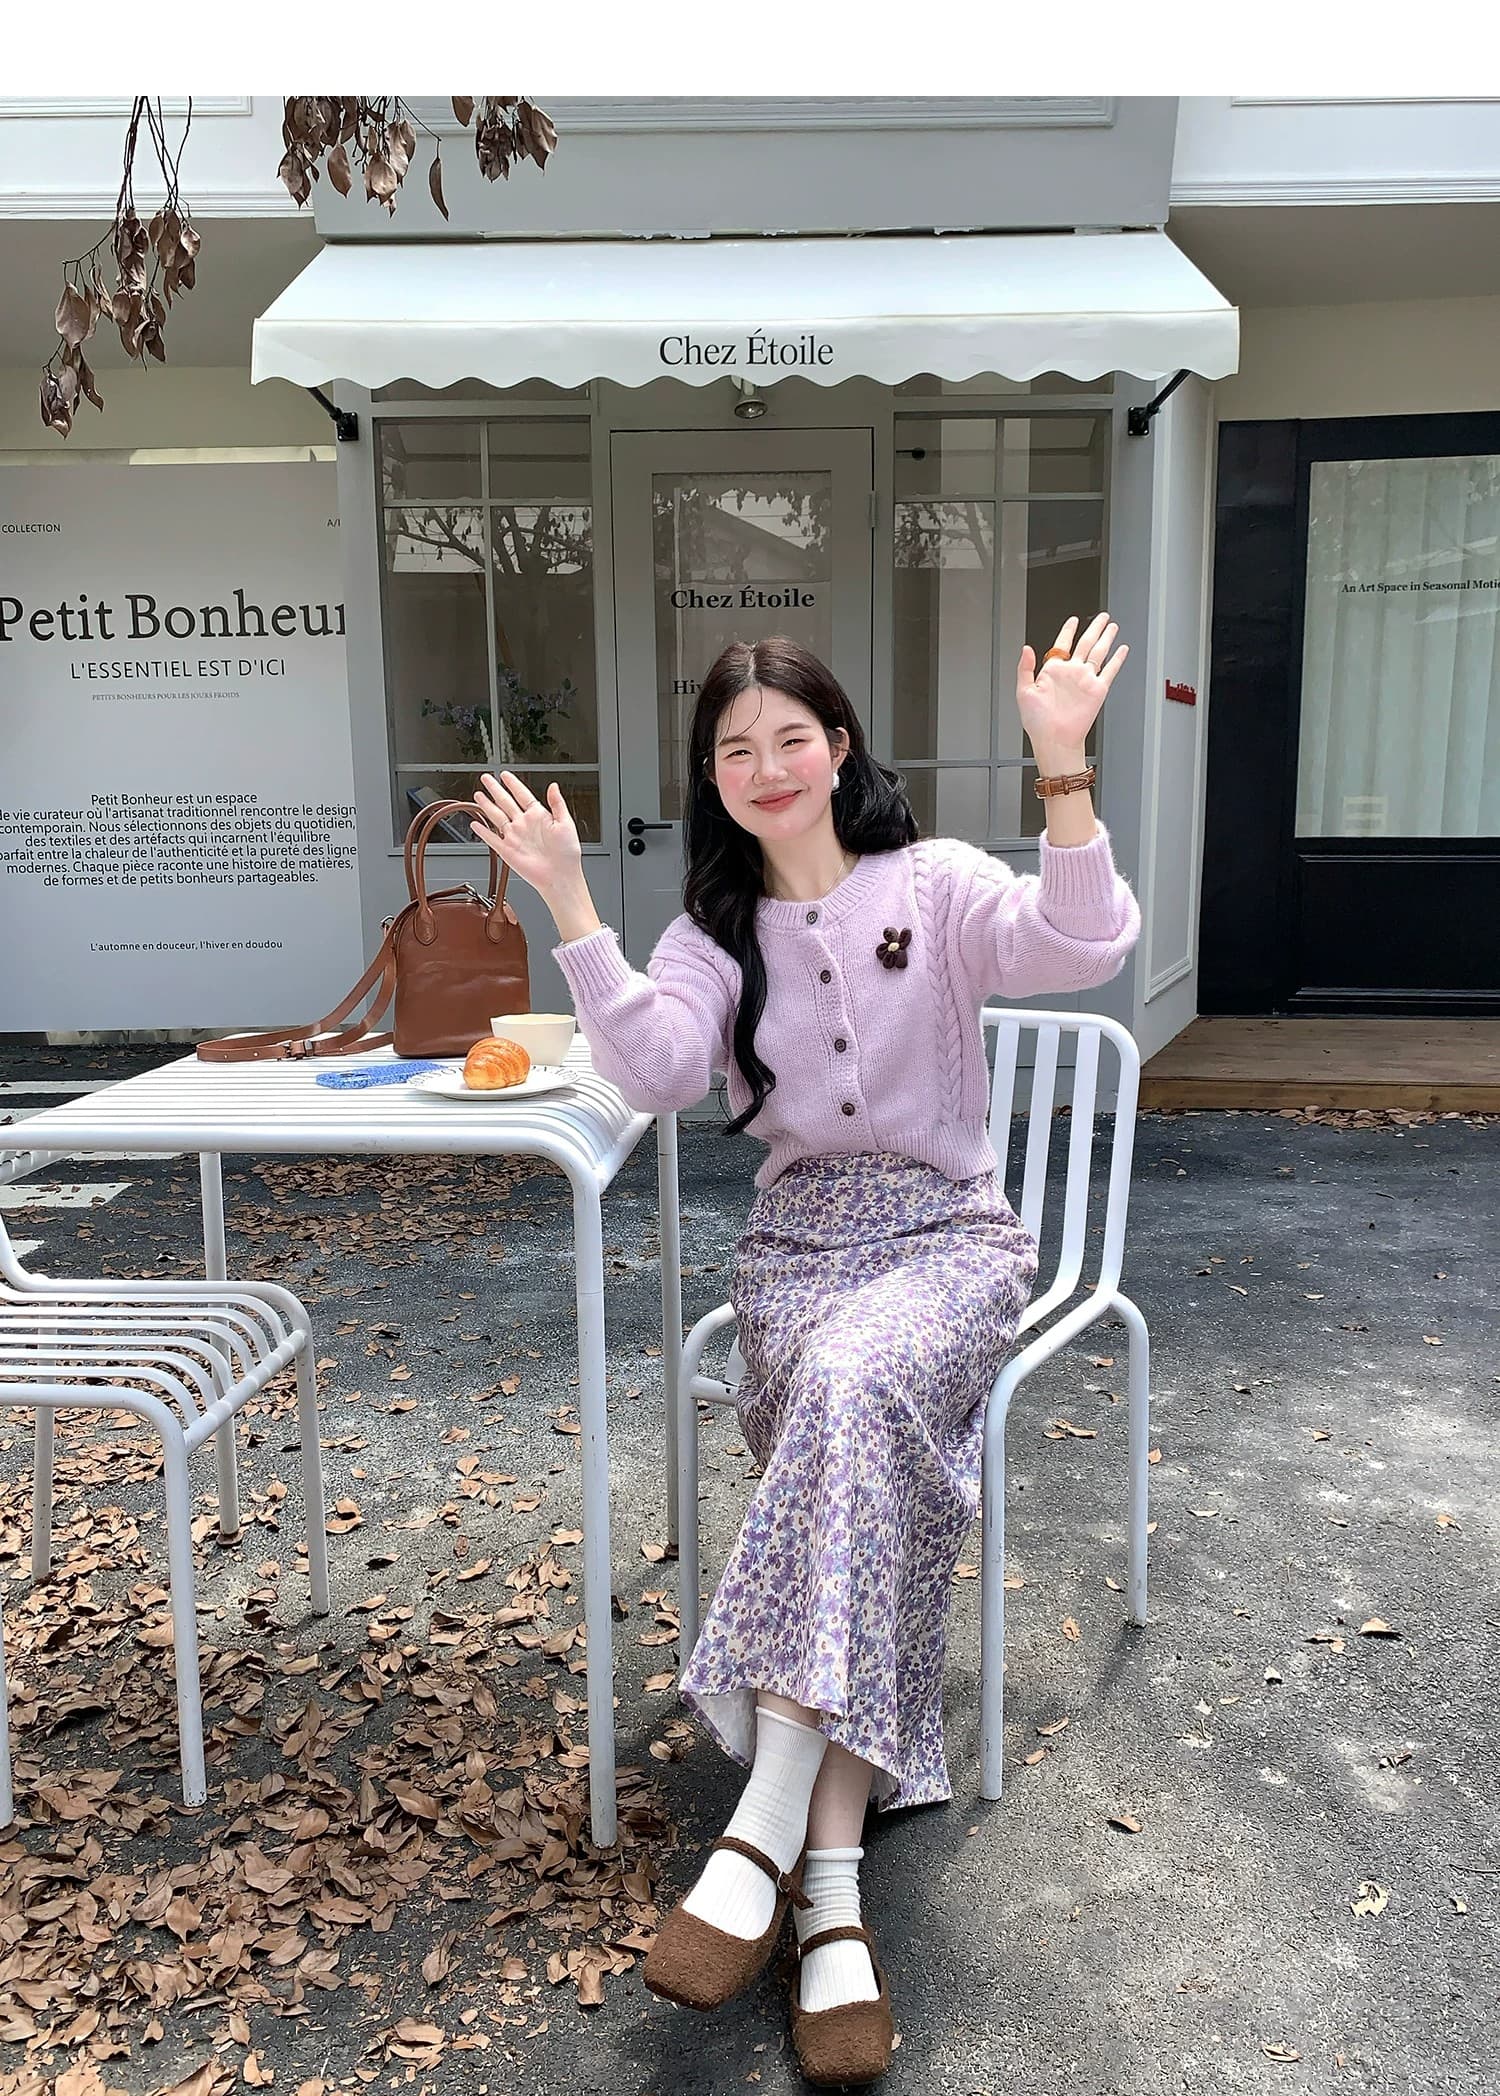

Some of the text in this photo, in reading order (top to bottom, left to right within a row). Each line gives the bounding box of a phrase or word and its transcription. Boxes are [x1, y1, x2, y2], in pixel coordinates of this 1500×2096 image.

[659, 328, 834, 365] Chez Étoile
[1, 524, 61, 533] COLLECTION
[1342, 583, 1356, 593] An
[1358, 583, 1375, 593] Art
[1377, 582, 1408, 594] Space
[1410, 581, 1421, 591] in
[1423, 580, 1470, 591] Seasonal
[670, 585, 815, 608] Chez Étoile
[0, 594, 116, 642] Petit
[70, 659, 287, 680] L'ESSENTIEL EST D'ICI
[157, 692, 177, 700] POUR
[190, 692, 213, 700] JOURS
[92, 793, 258, 806] Petit Bonheur est un espace
[13, 809, 30, 820] vie
[33, 811, 84, 820] curateur
[86, 808, 102, 819] où
[105, 807, 164, 819] l'artisanat
[167, 805, 237, 817] traditionnel
[240, 806, 299, 816] rencontre
[302, 804, 313, 816] le
[316, 804, 357, 818] design
[0, 817, 356, 835] contemporain. Nous sélectionnons des objets du quotidien,
[25, 831, 330, 847] des textiles et des artéfacts qui incarnent l'équilibre
[37, 850, 69, 860] entre
[71, 848, 82, 859] la
[85, 847, 129, 859] chaleur
[132, 847, 147, 858] de
[150, 846, 229, 858] l'authenticité
[231, 846, 243, 857] et
[247, 845, 257, 856] la
[261, 844, 300, 859] pureté
[303, 844, 324, 856] des
[7, 857, 354, 875] modernes. Chaque pièce raconte une histoire de matières,
[43, 871, 319, 887] de formes et de petits bonheurs partageables.
[90, 943, 140, 951] L'automne
[156, 942, 198, 951] douceur,
[200, 940, 230, 949] l'hiver
[245, 940, 282, 949] doudou
